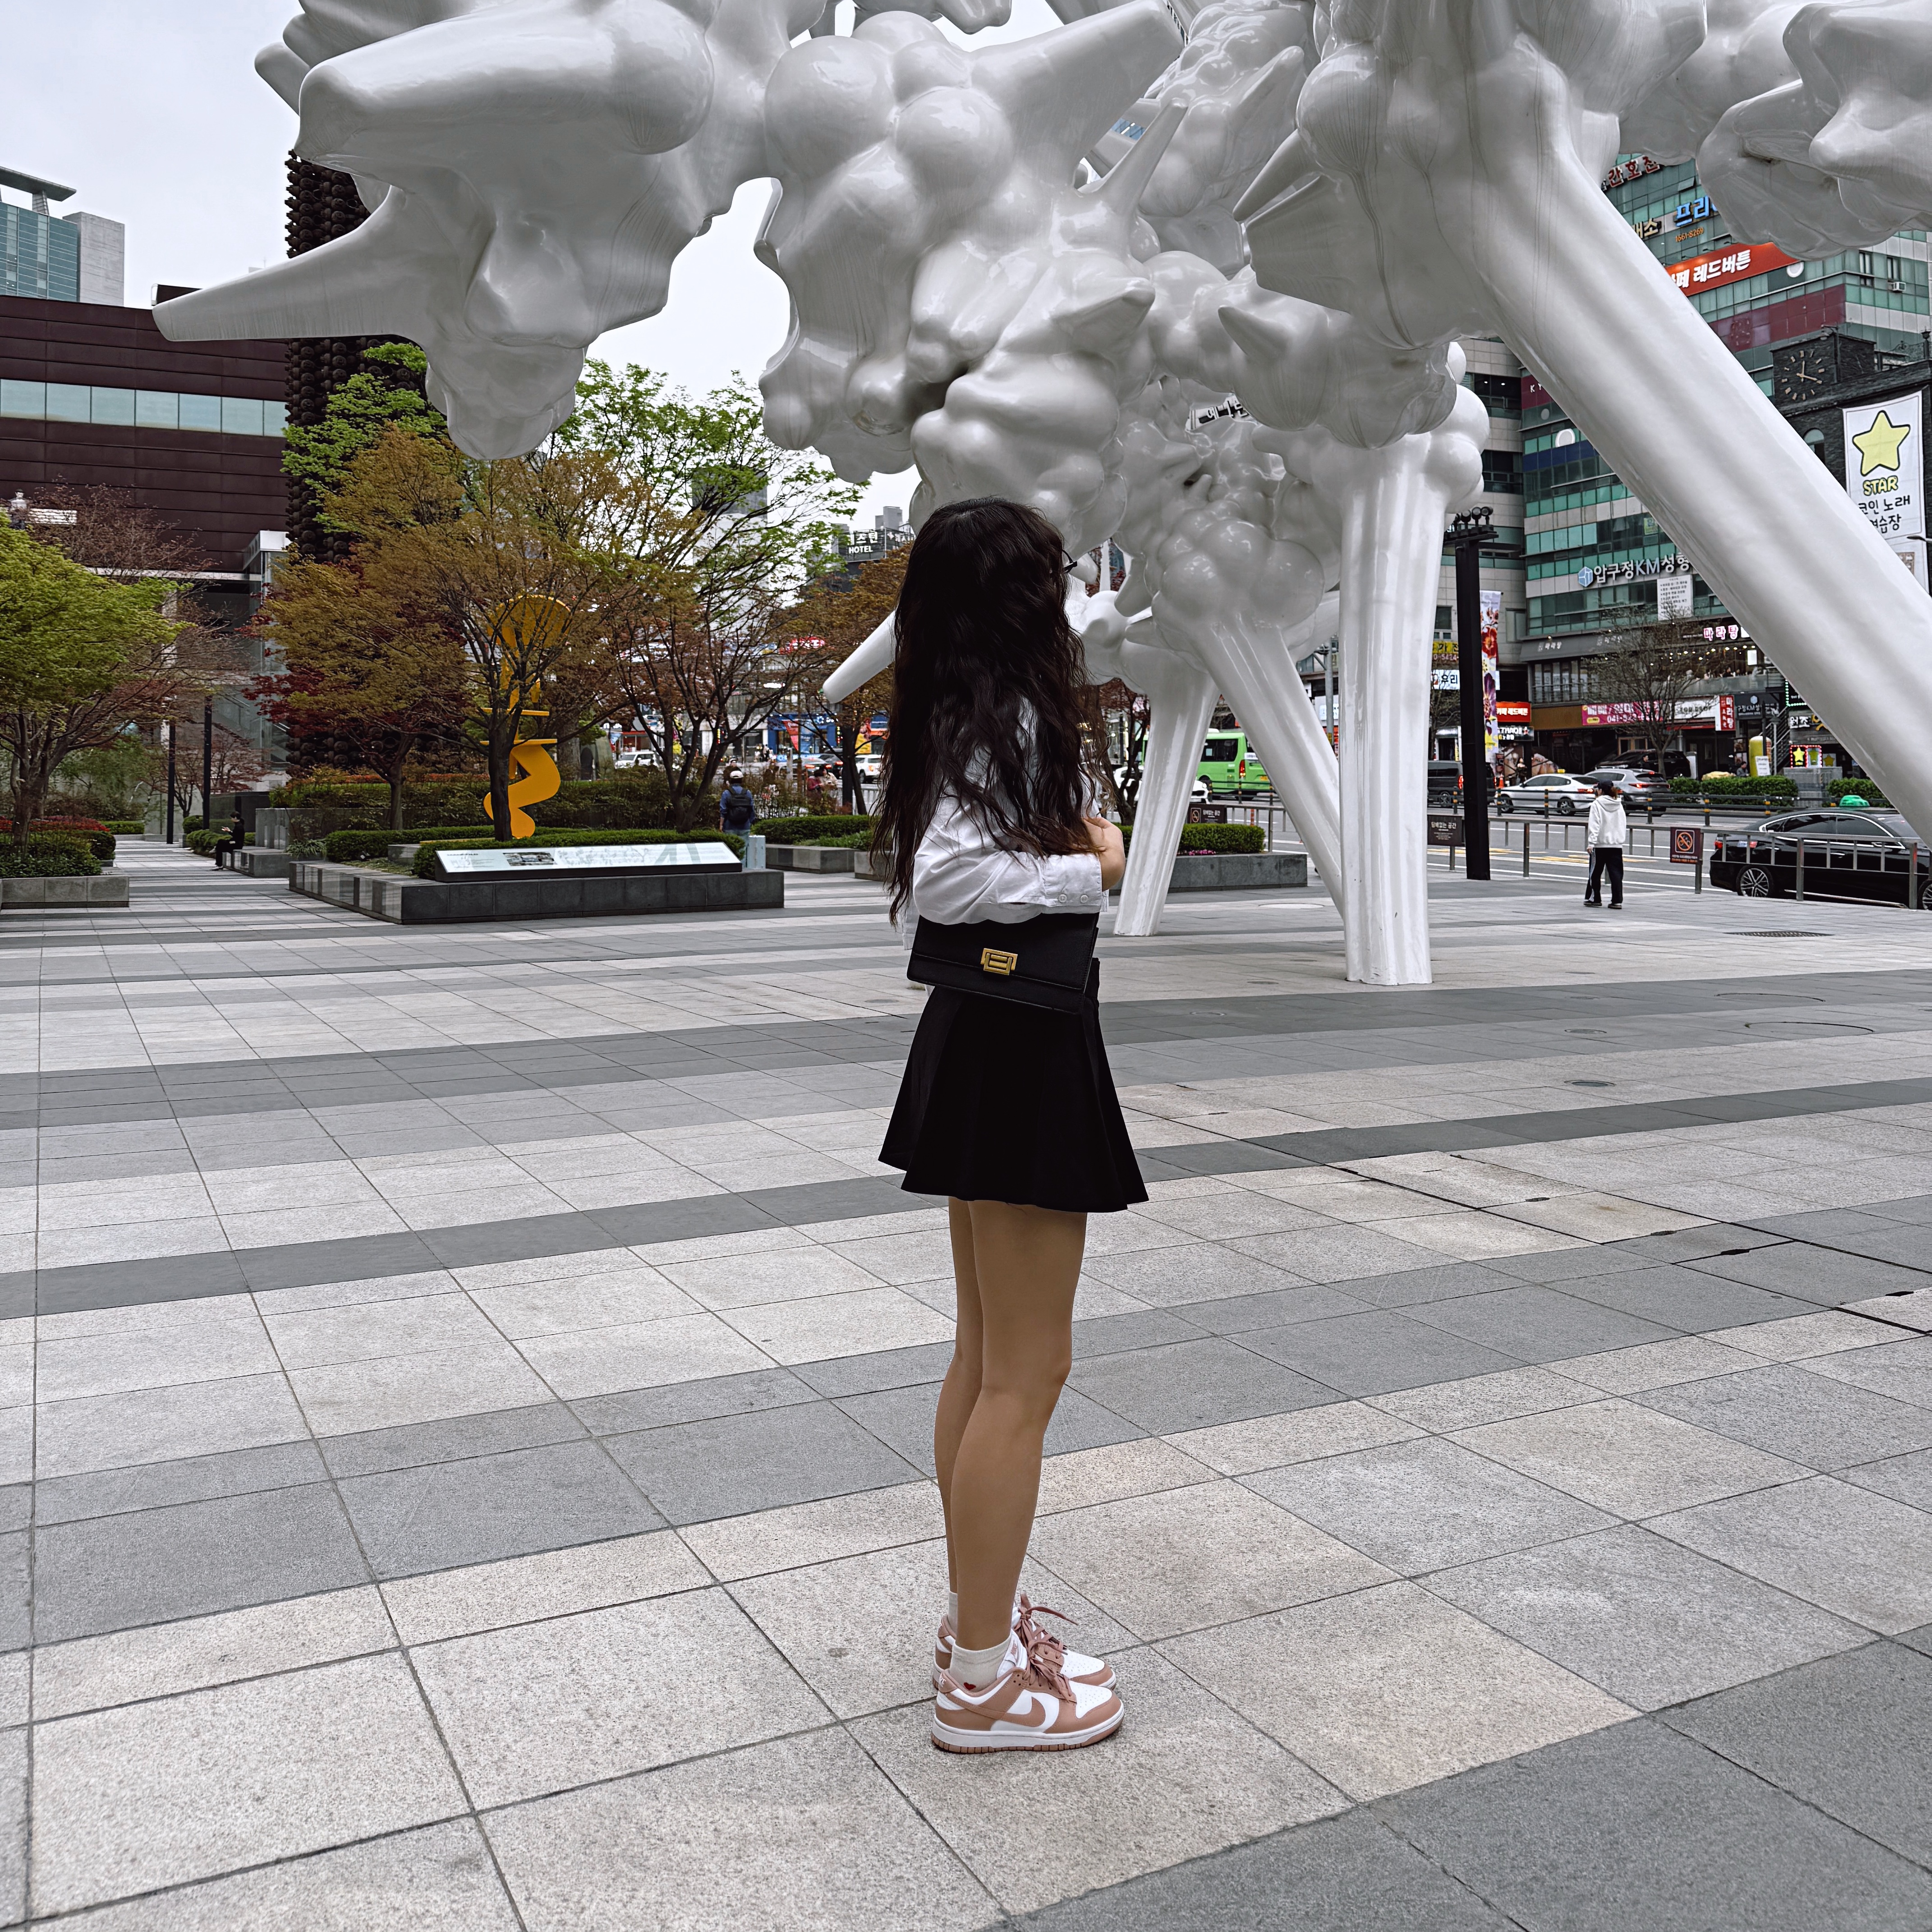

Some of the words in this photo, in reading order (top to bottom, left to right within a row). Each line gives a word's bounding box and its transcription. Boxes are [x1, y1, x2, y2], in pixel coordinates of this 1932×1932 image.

[1675, 196, 1717, 227] 프리
[1693, 249, 1751, 282] 레드버튼
[1863, 475, 1898, 496] STAR
[1883, 495, 1910, 511] 노래
[849, 546, 873, 554] HOTEL
[1703, 625, 1739, 641] 마라탕
[1441, 675, 1458, 684] 우리
[1790, 716, 1810, 729] 원조
